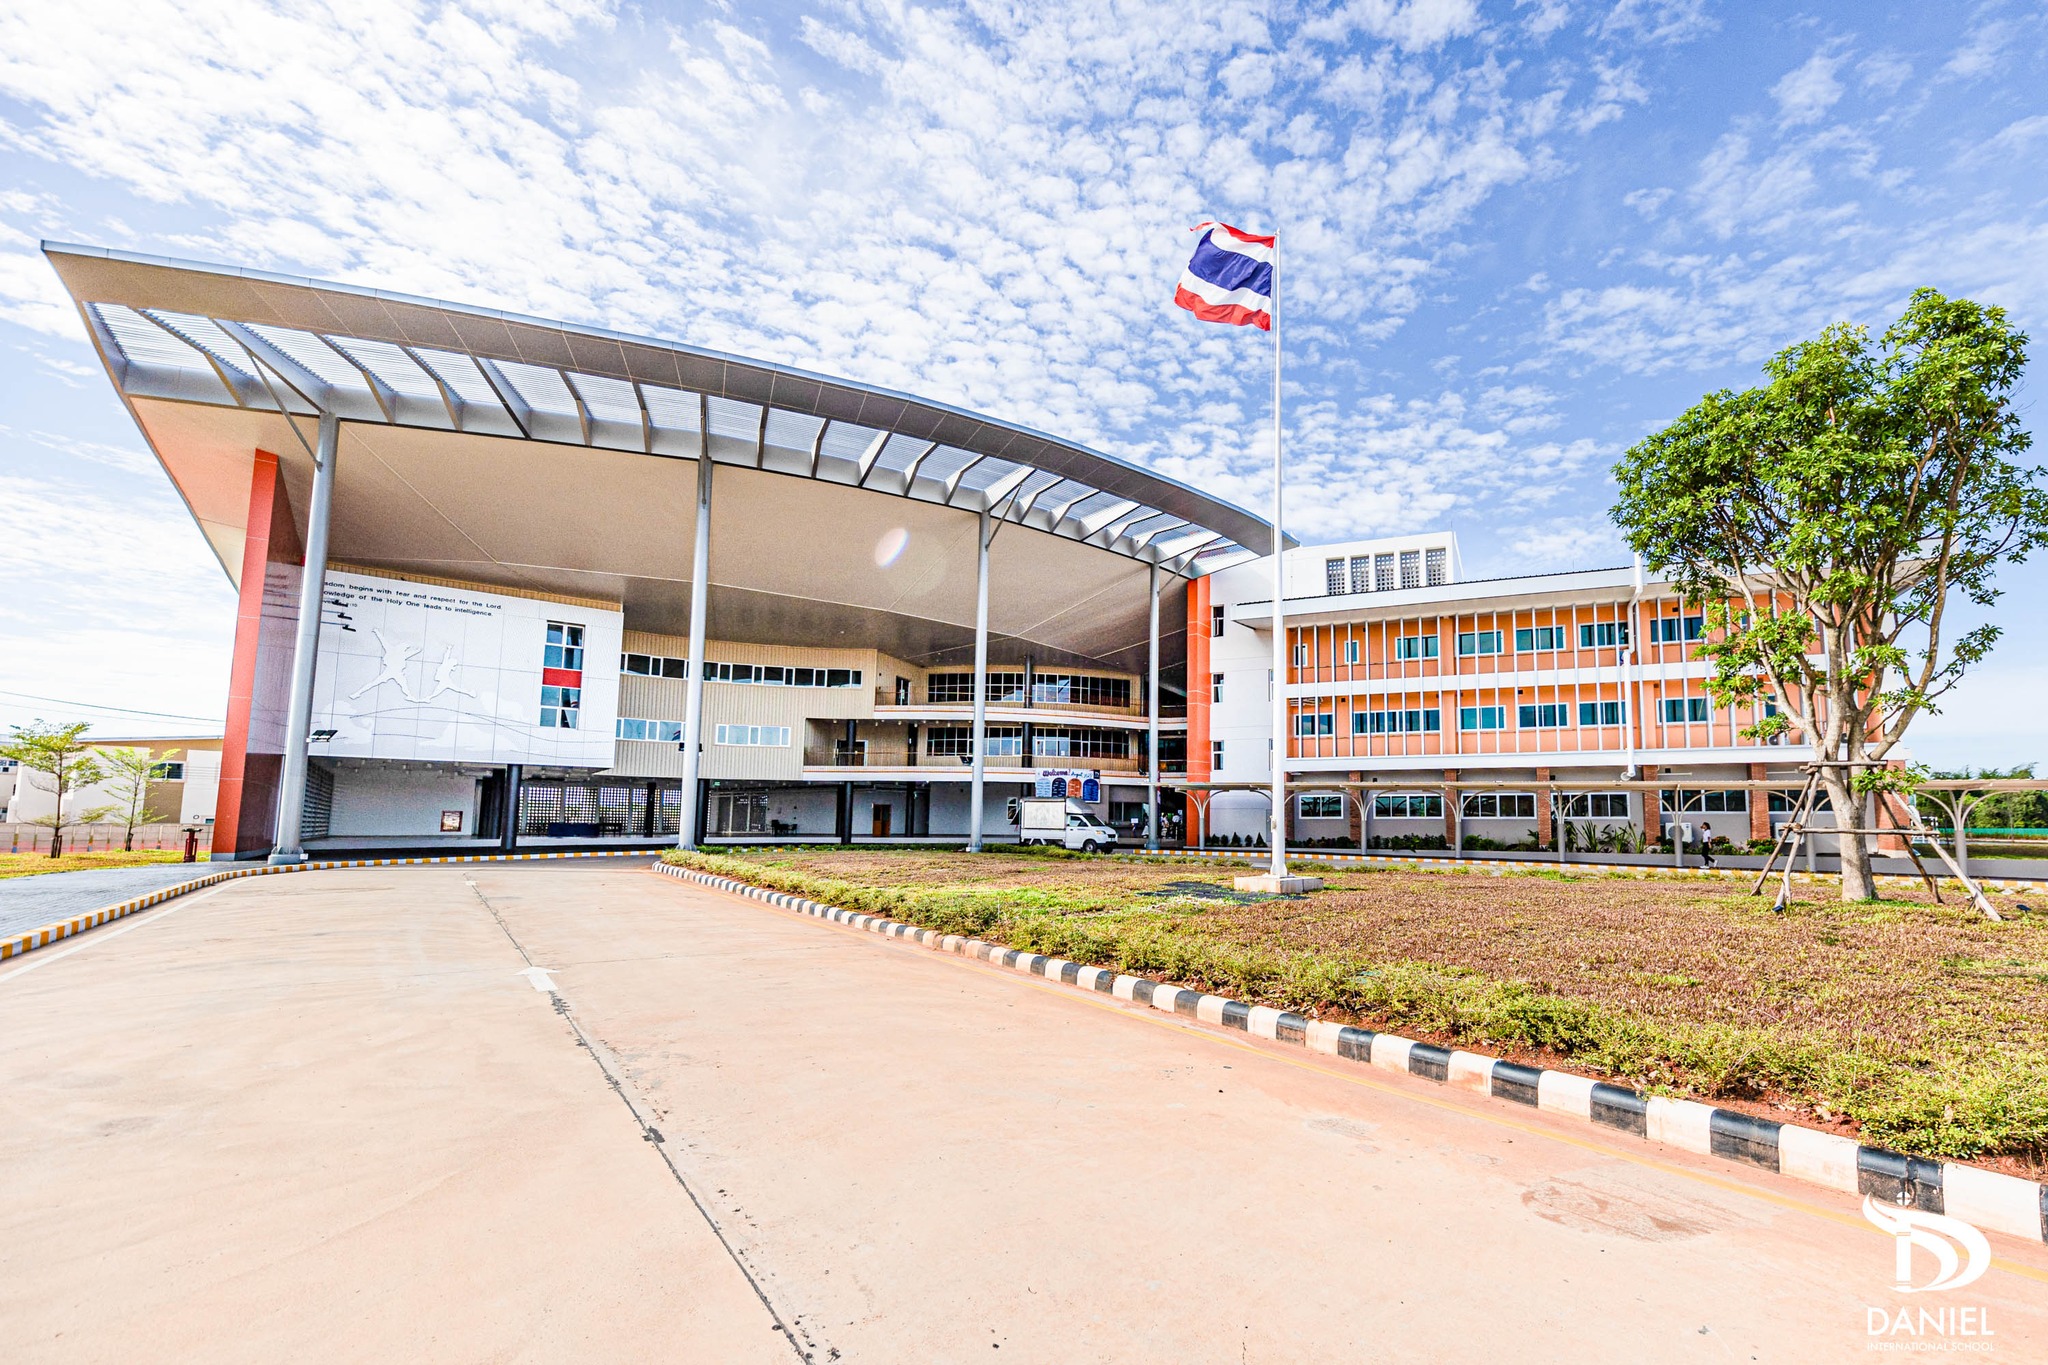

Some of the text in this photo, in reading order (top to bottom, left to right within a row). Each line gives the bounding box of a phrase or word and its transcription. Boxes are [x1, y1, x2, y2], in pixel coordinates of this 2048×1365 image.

[323, 590, 355, 599] owledge
[386, 598, 402, 606] Holy
[349, 584, 373, 592] begins
[430, 595, 456, 603] respect
